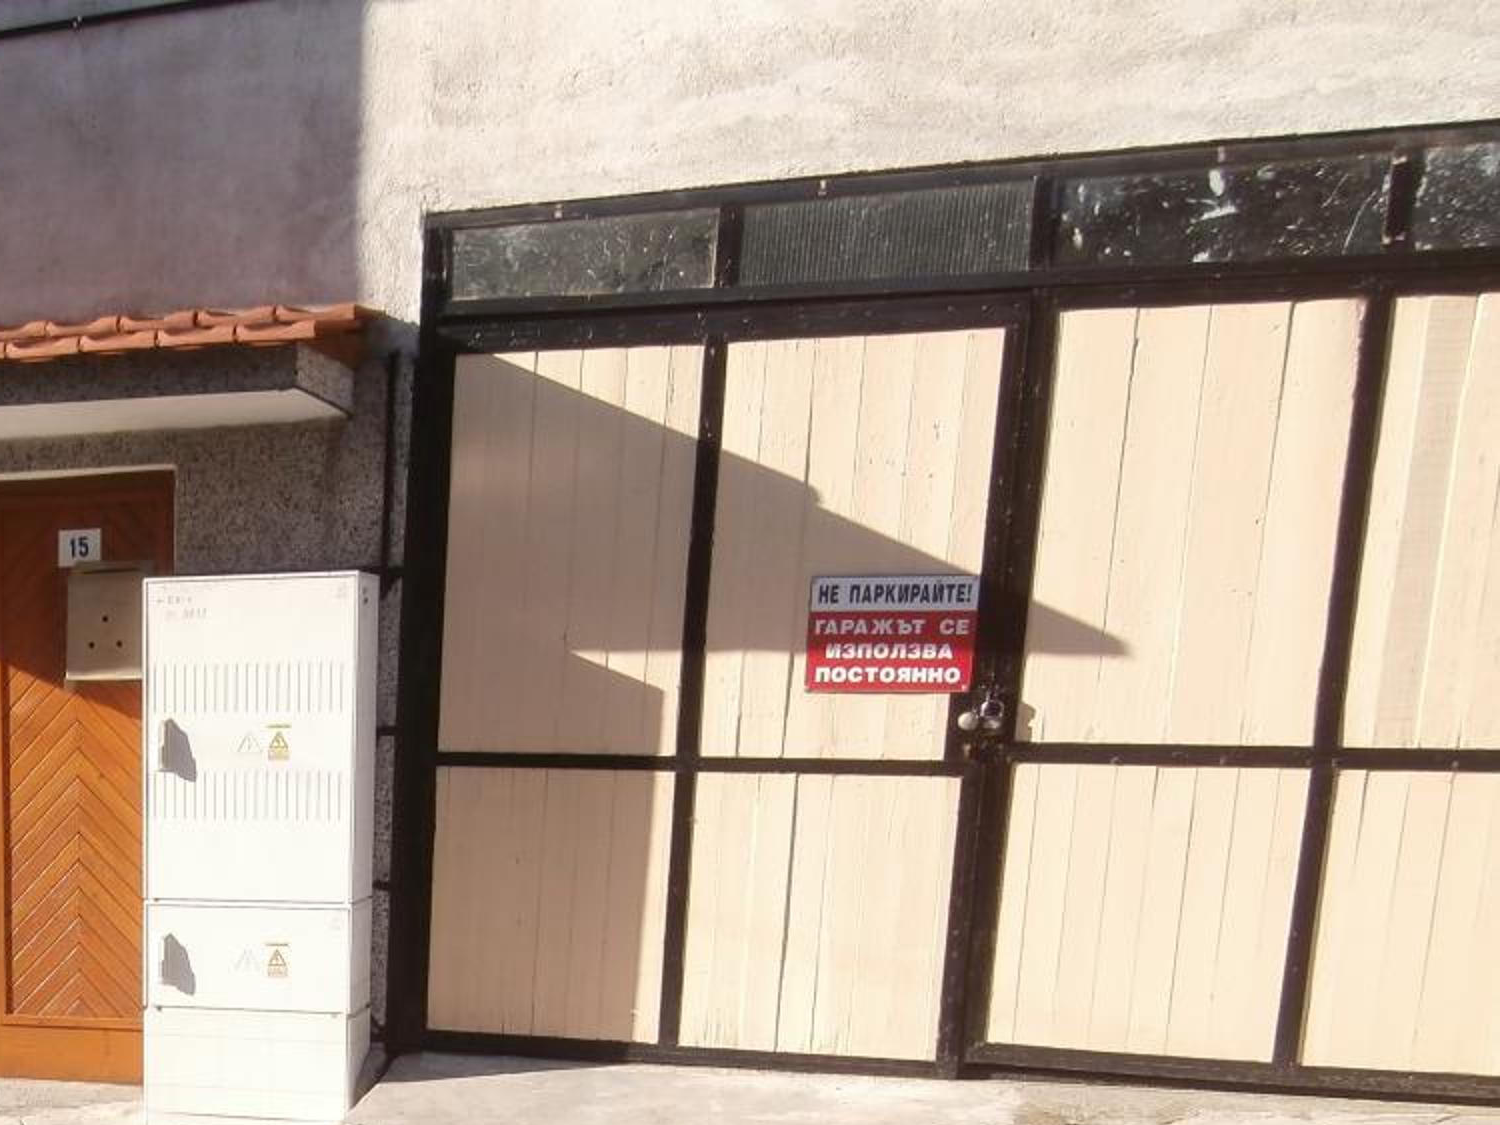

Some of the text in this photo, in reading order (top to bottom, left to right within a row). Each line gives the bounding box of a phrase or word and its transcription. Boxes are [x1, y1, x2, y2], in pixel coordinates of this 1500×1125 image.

[70, 536, 89, 559] 15
[819, 581, 972, 604] НЕ ПАРКИРАЙТЕ!
[815, 618, 969, 635] ГАРАЖЪТ СЕ
[826, 643, 952, 659] ИЗПОЛЗВА
[815, 666, 960, 683] ПОСТОЯННО
